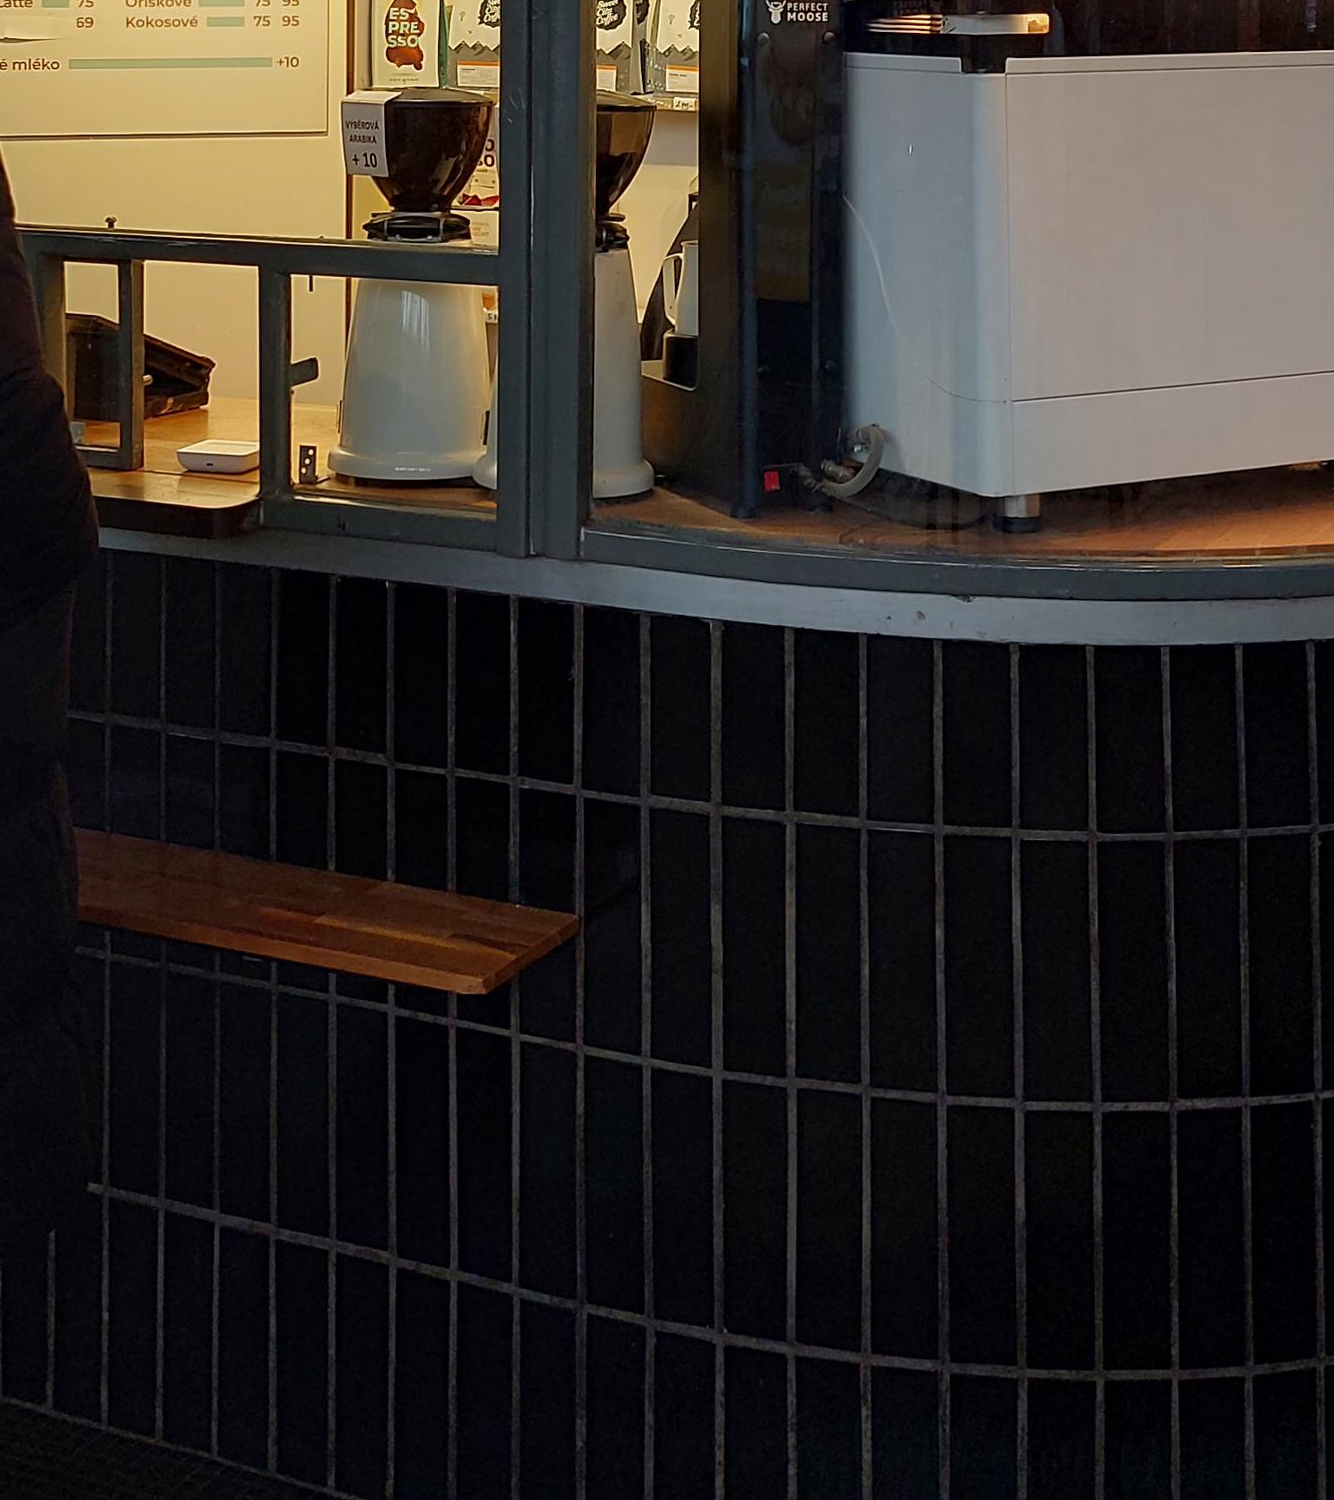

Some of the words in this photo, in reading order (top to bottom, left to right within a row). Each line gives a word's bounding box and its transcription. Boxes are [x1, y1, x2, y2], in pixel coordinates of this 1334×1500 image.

[787, 2, 828, 12] PERFECT
[389, 8, 409, 20] ES
[787, 12, 829, 22] MOOSE
[76, 17, 94, 28] 69
[125, 16, 198, 28] Kokosové
[253, 16, 271, 27] 75
[282, 16, 300, 27] 95
[388, 21, 420, 34] PRE
[388, 35, 419, 48] SSO
[12, 58, 60, 70] mléko
[276, 56, 300, 68] +10
[345, 119, 379, 130] VÝBĚROVÁ
[349, 135, 377, 144] ARABIKA
[363, 152, 378, 168] 10
